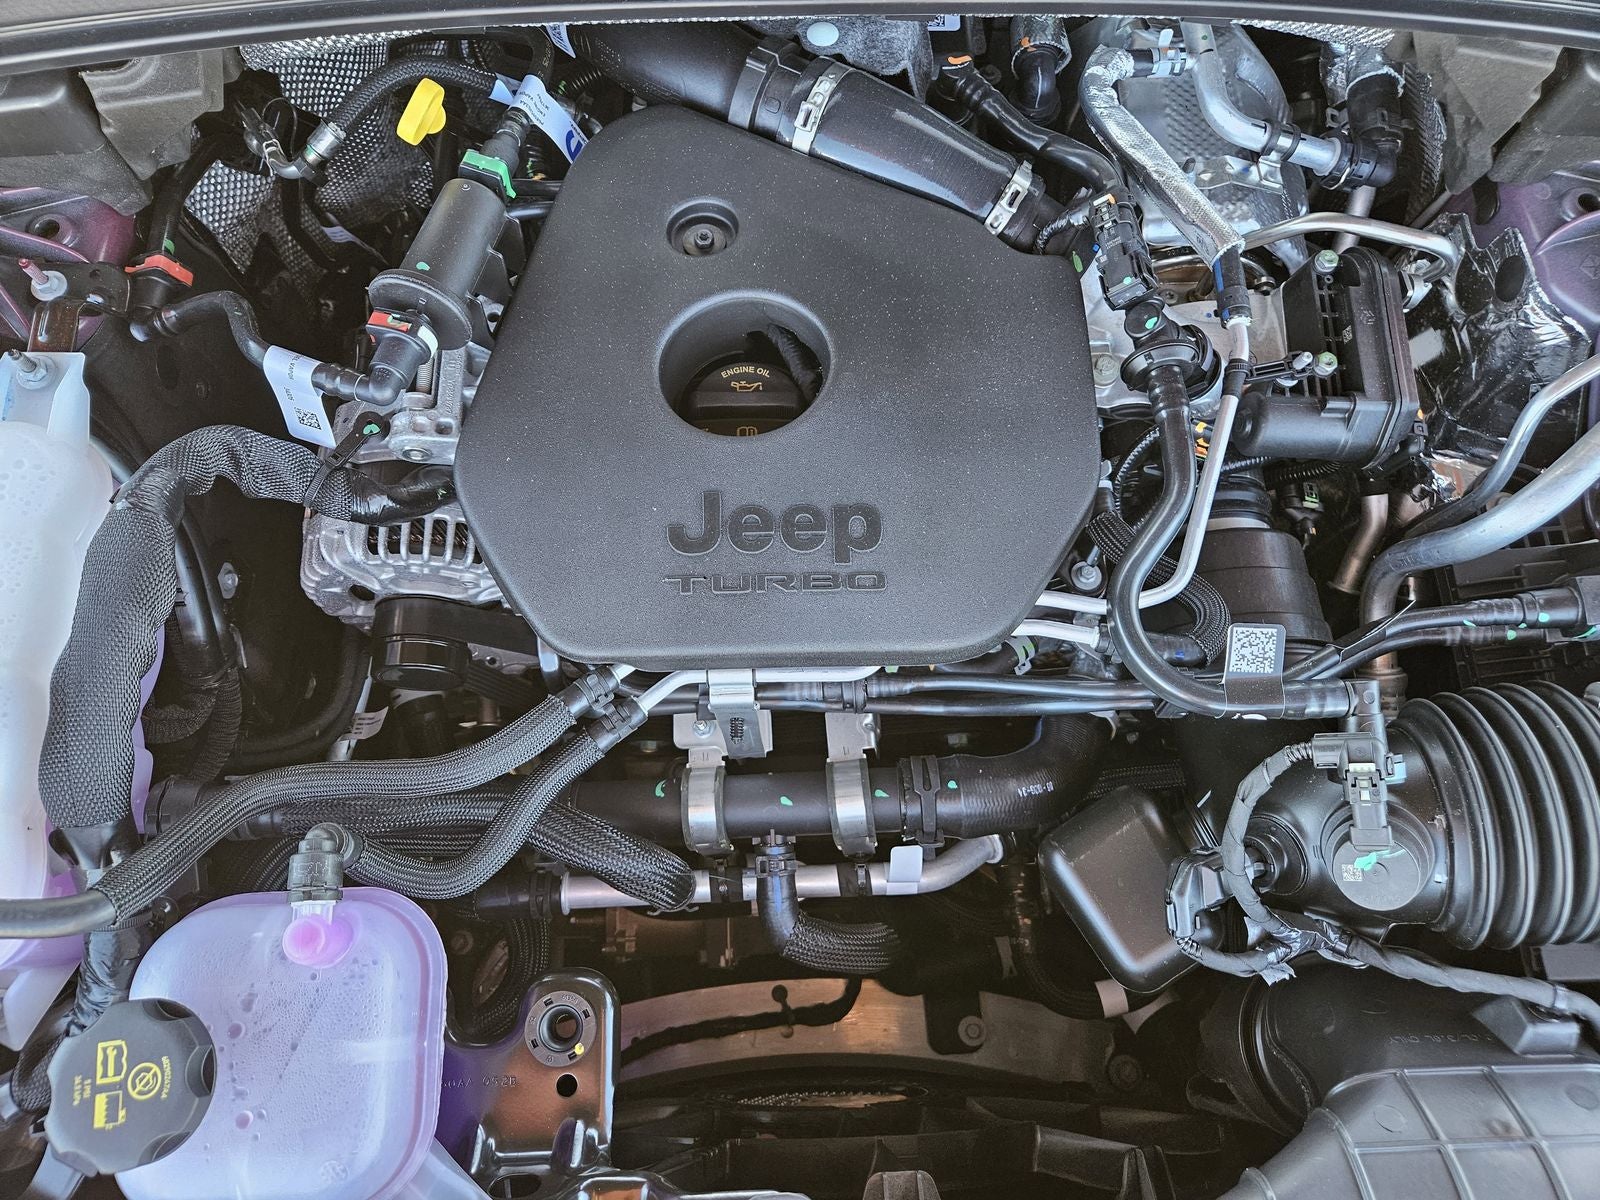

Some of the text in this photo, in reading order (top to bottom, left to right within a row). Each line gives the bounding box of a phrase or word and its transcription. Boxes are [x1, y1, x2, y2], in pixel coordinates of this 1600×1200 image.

[720, 365, 771, 379] ENGINE OIL
[666, 490, 883, 566] Jeep
[663, 572, 888, 595] TURBO
